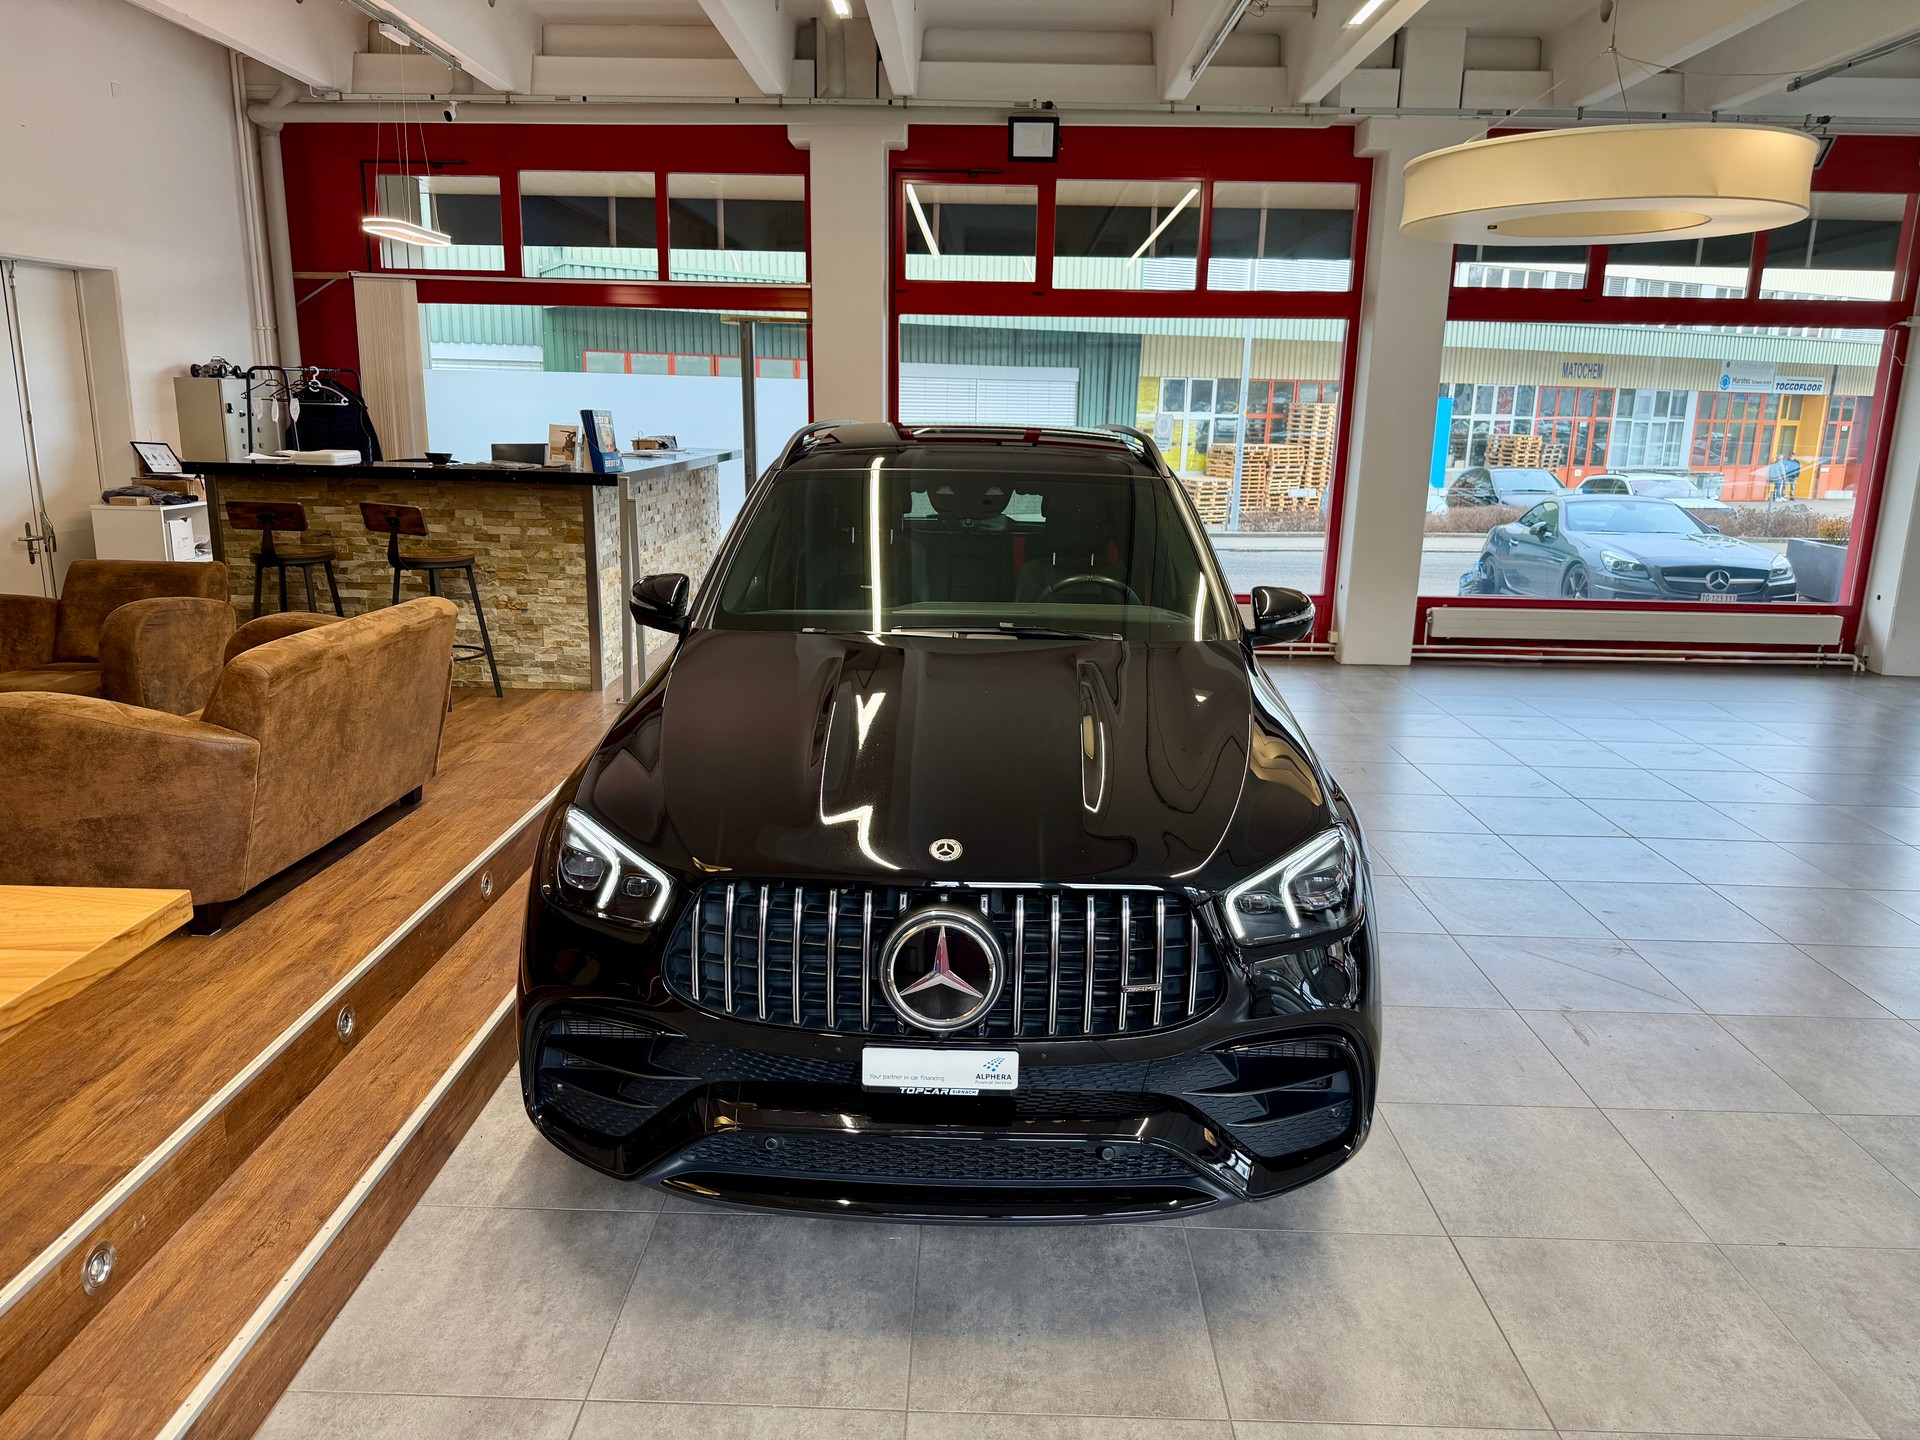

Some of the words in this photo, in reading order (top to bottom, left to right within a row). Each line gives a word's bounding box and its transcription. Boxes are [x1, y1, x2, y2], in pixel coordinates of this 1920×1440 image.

[1562, 362, 1603, 379] MATOCHEM
[1775, 382, 1822, 392] TOGGOFLOOR
[900, 1086, 949, 1095] TOPCAR
